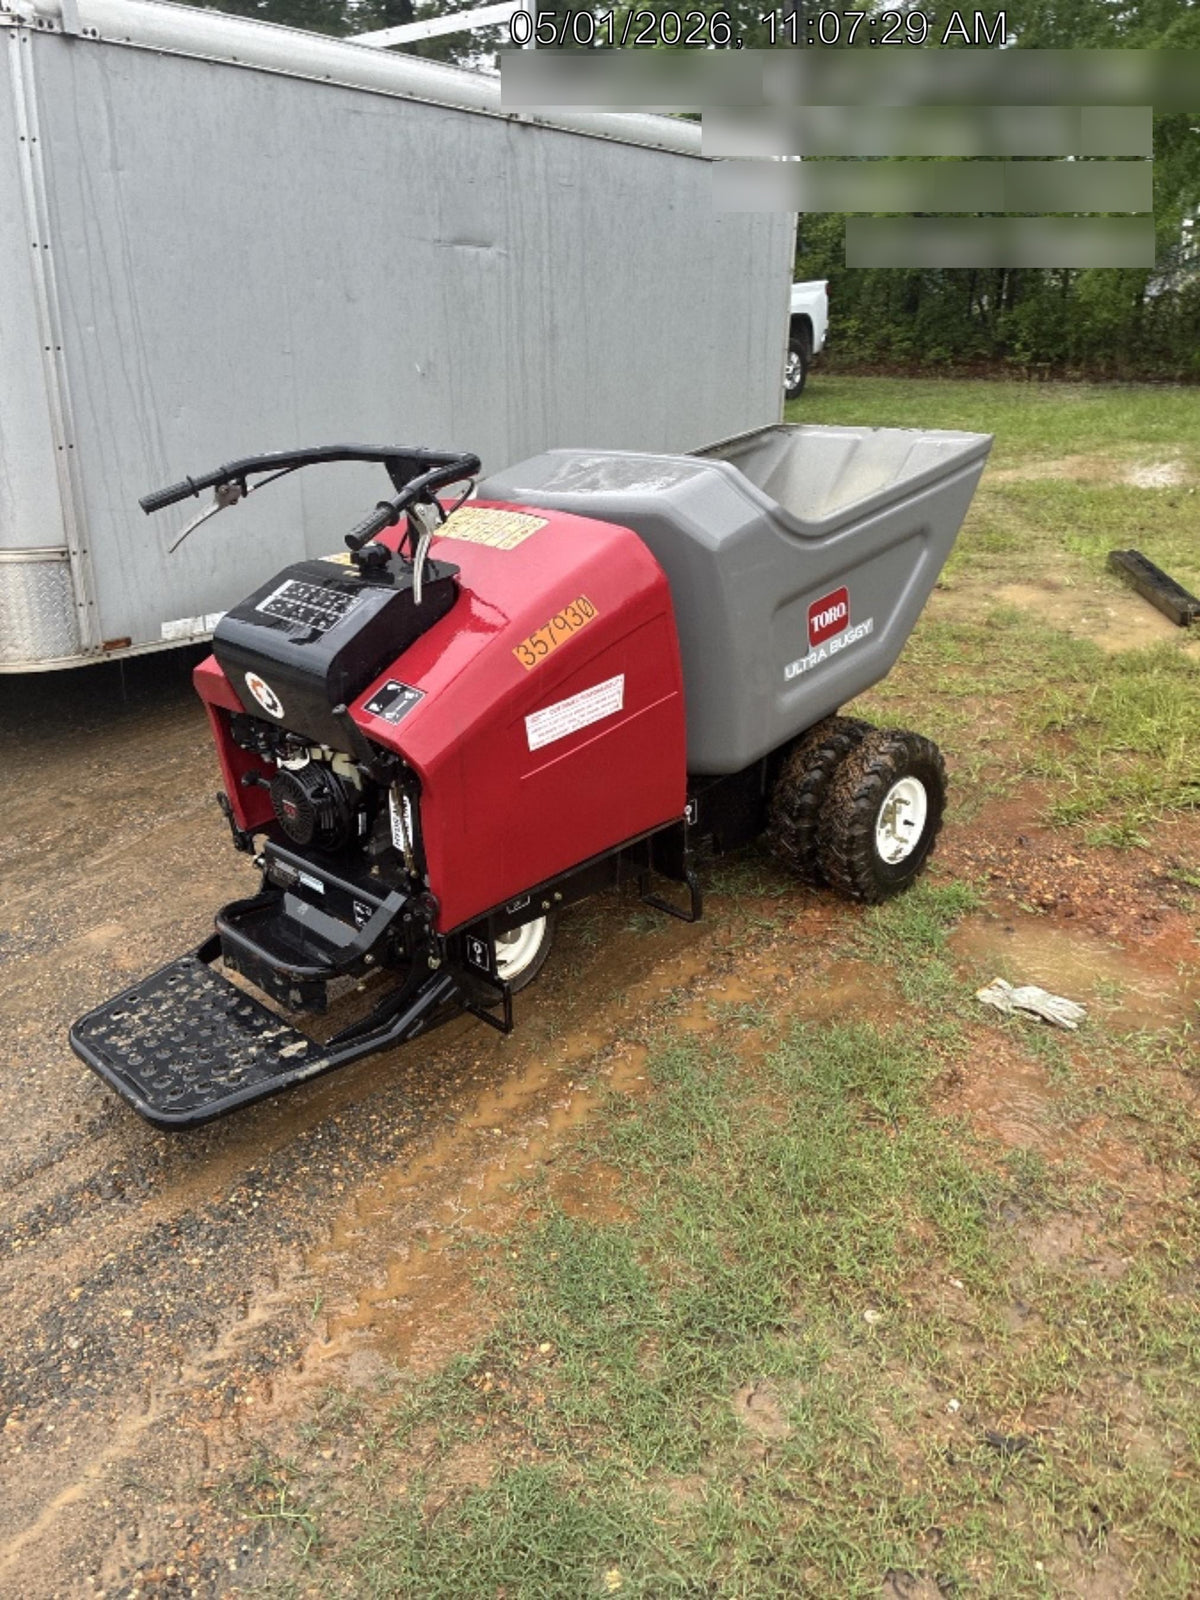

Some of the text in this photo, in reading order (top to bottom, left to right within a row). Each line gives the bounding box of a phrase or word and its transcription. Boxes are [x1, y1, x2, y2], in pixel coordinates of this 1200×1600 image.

[515, 595, 597, 667] 357930
[811, 602, 847, 632] TORO
[785, 621, 871, 679] ULTRA BUGGY
